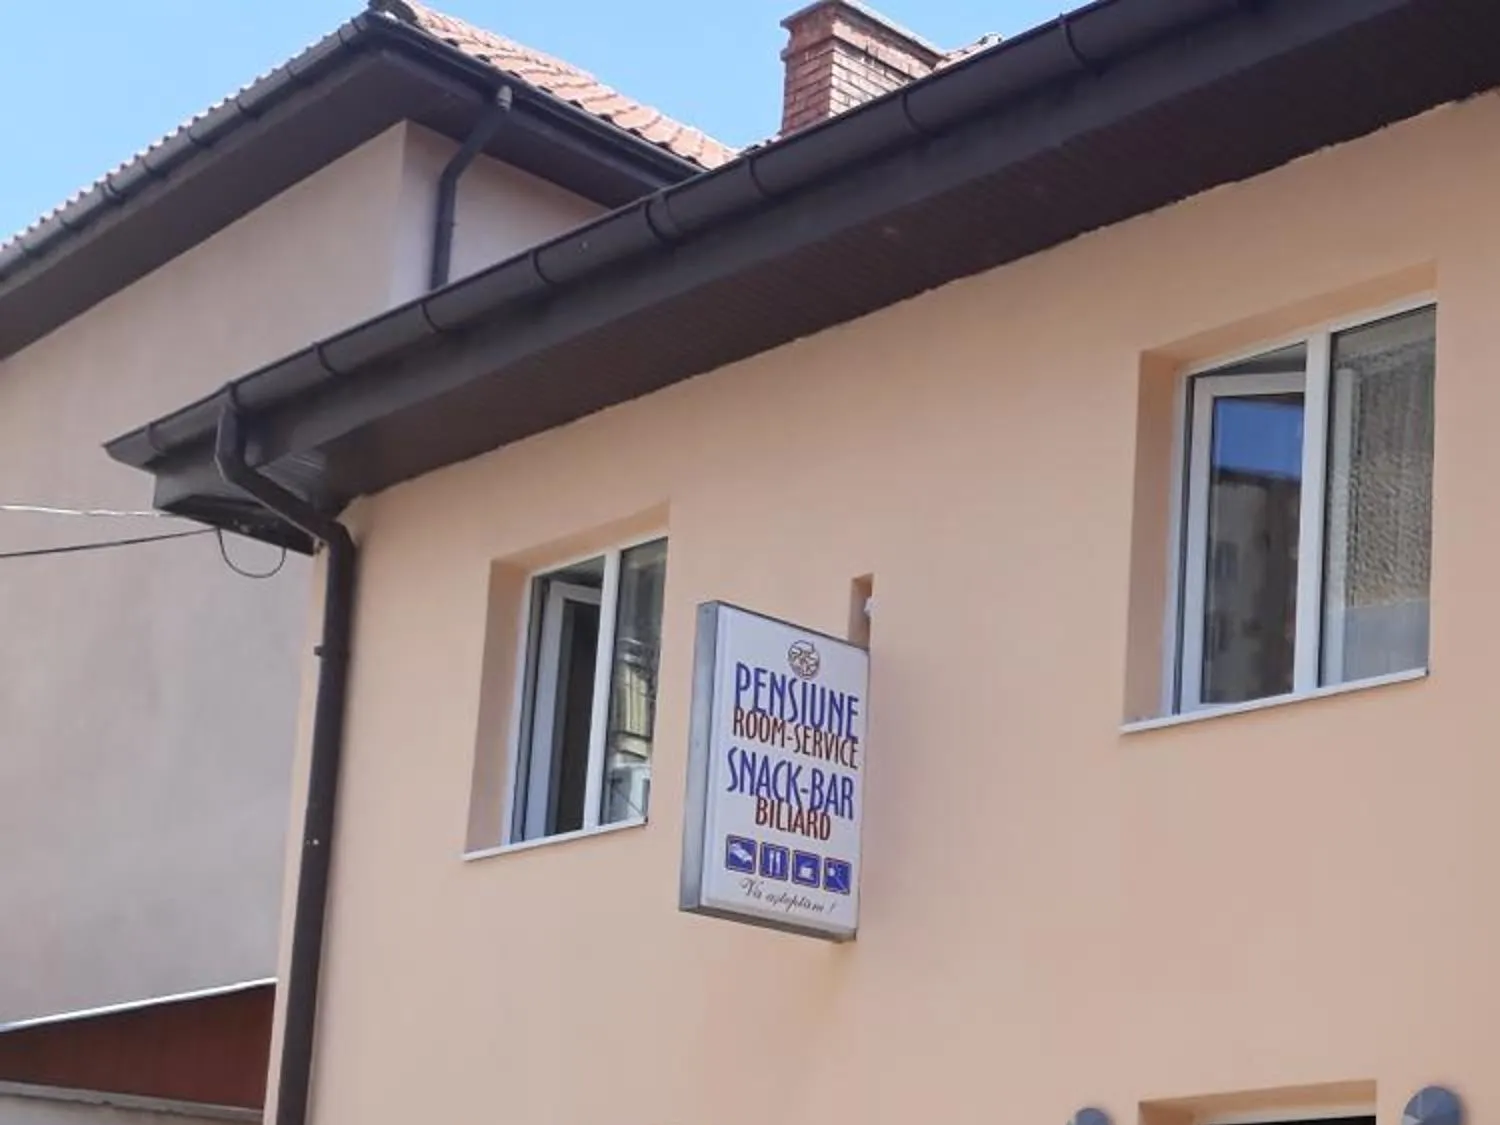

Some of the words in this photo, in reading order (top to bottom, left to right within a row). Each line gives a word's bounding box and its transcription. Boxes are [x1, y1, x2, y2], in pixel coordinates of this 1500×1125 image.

[736, 661, 859, 742] PENSIUNE
[733, 706, 859, 770] ROOM-SERVICE
[726, 746, 854, 820] SNACK-BAR
[755, 796, 831, 841] BILIARD
